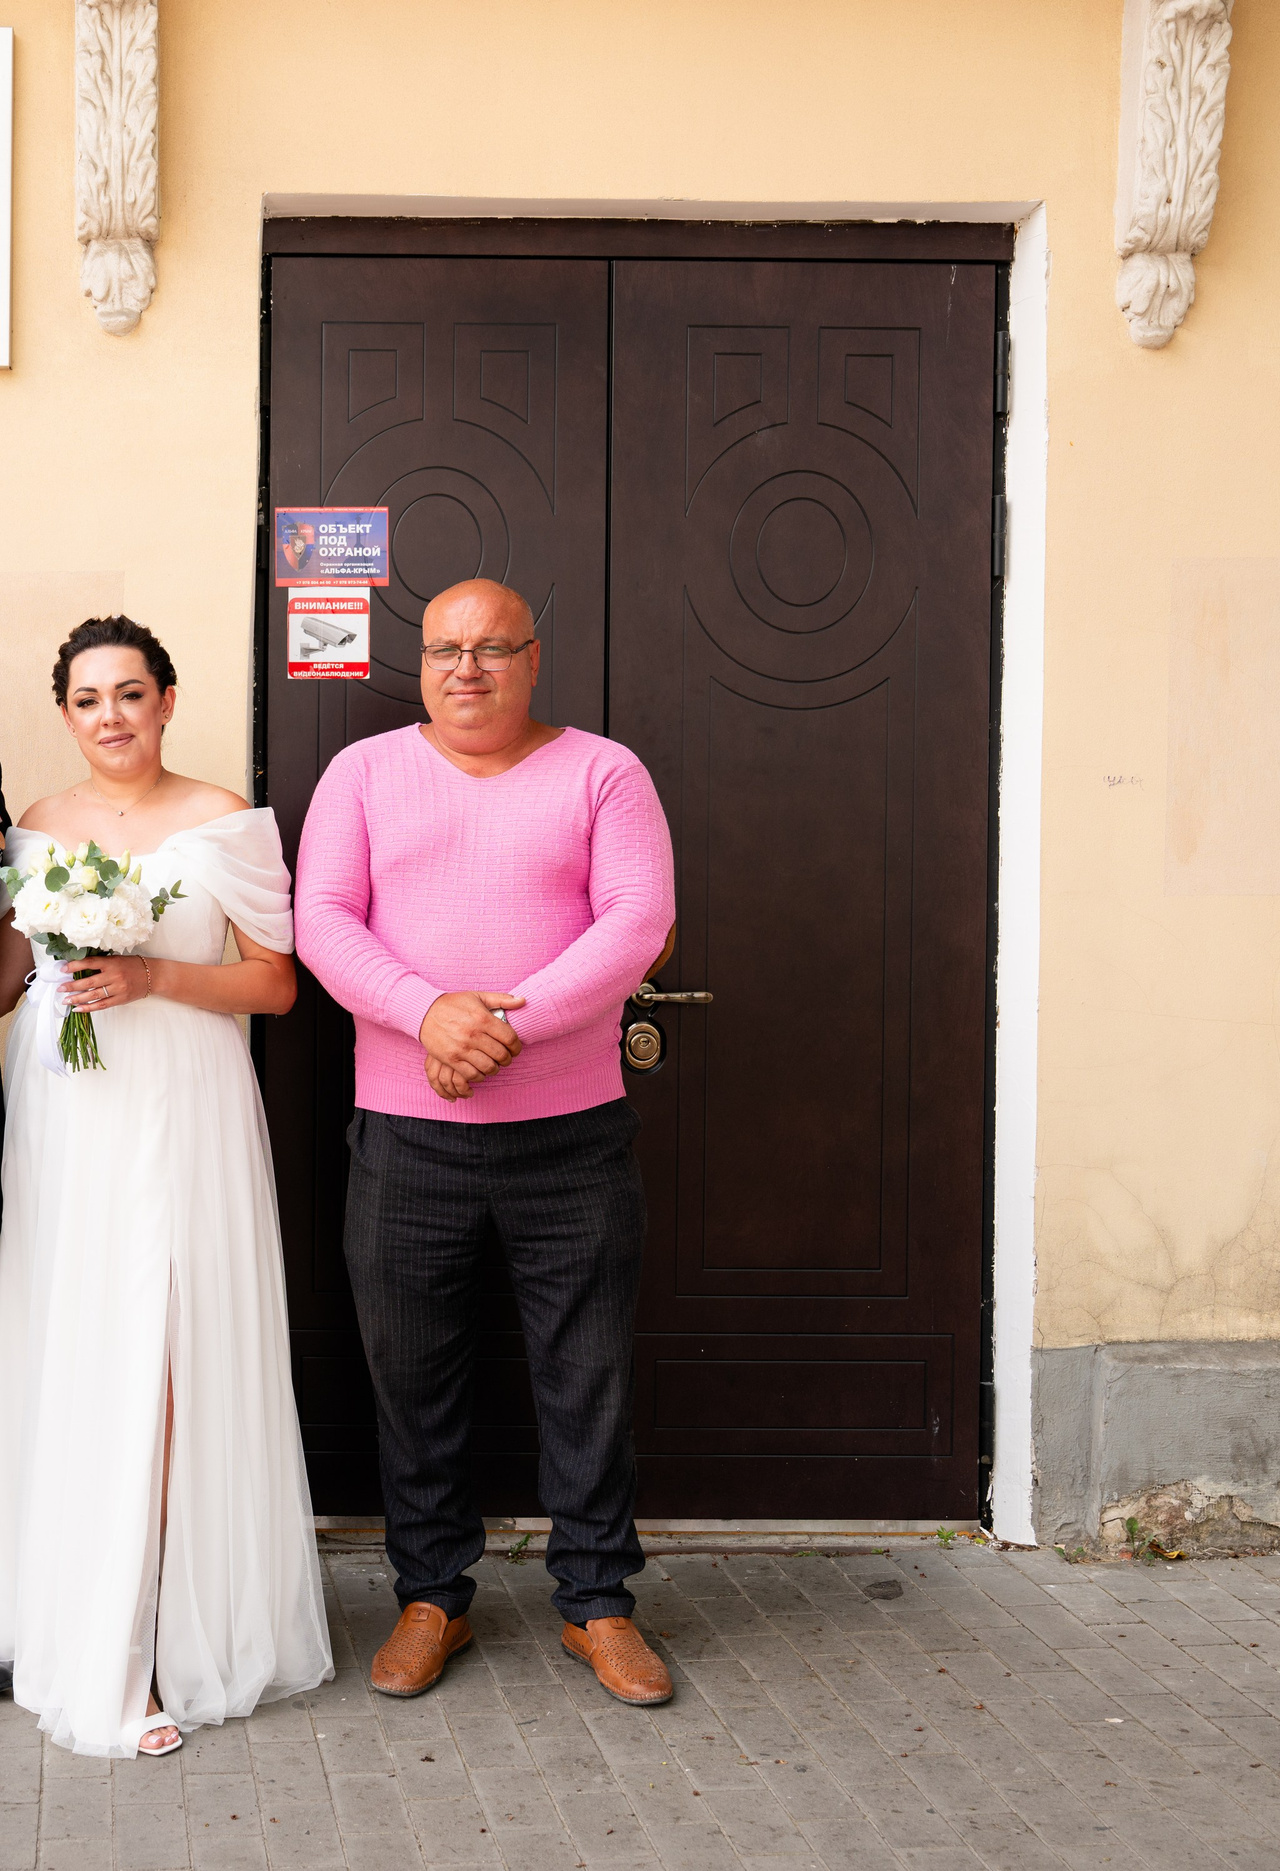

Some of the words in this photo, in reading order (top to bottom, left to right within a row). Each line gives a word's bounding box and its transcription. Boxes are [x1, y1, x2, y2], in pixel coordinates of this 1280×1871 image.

[319, 524, 372, 534] ОБЪЕКТ
[319, 536, 347, 546] ПОД
[319, 546, 381, 557] ОХРАНОЙ
[294, 601, 363, 610] ВНИМАНИЕ!!!
